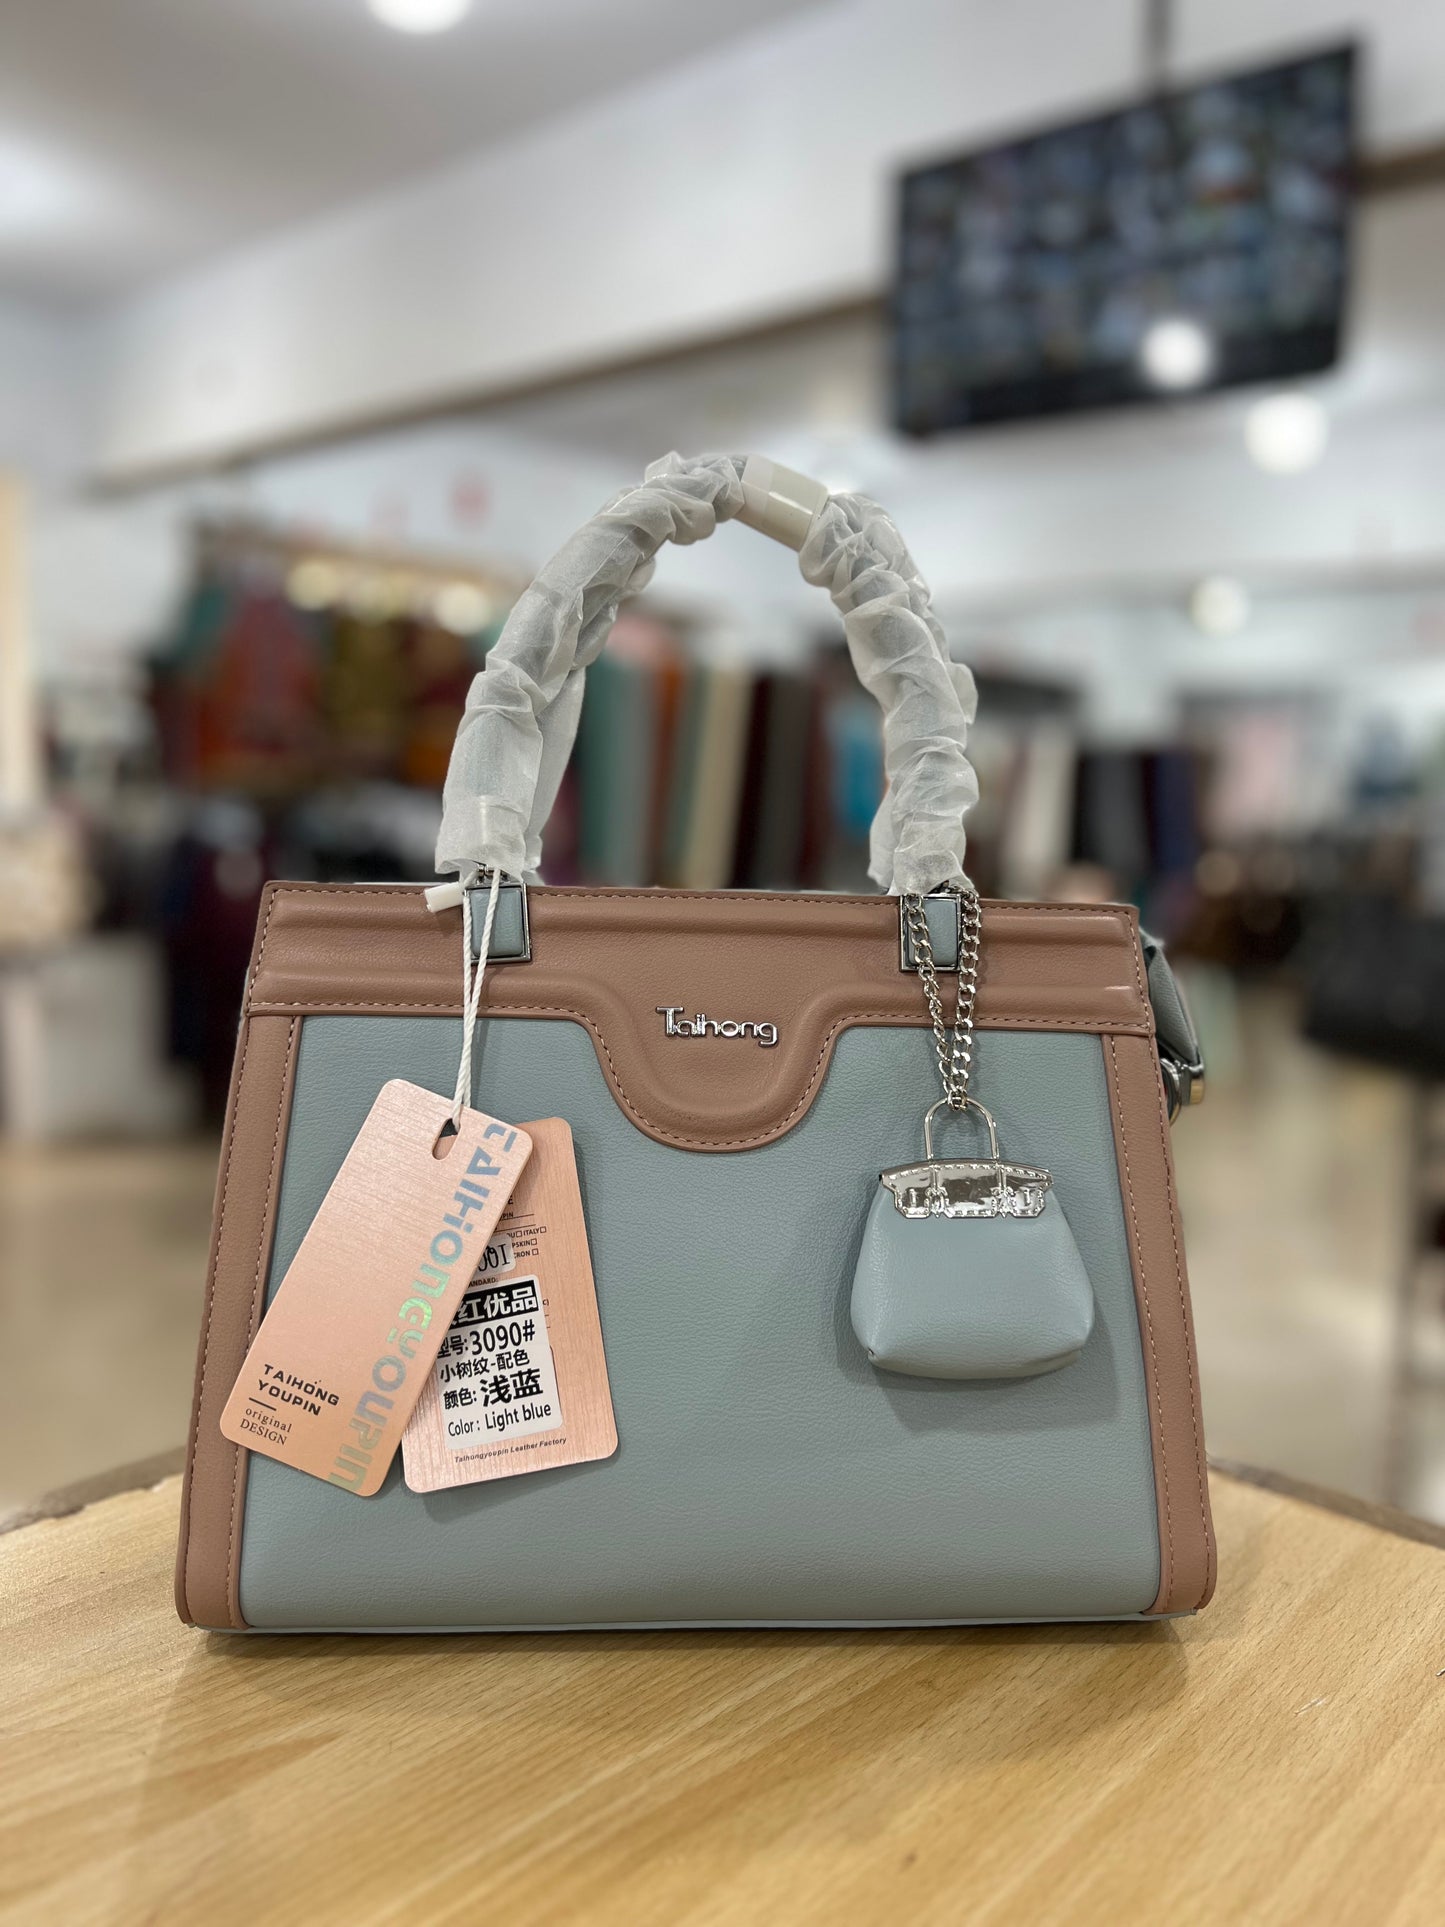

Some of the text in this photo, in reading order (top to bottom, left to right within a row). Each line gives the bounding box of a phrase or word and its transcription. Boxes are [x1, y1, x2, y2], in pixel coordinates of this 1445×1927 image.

[655, 1005, 779, 1048] Taihong
[523, 1227, 540, 1236] ITALY
[450, 1286, 538, 1326] 红优品
[258, 1378, 322, 1417] YOUPIN
[239, 1417, 288, 1446] DESIGN
[245, 1407, 292, 1433] original
[485, 1407, 520, 1432] Light
[521, 1402, 552, 1422] blue
[510, 1442, 538, 1453] Leather
[539, 1437, 567, 1448] Factory
